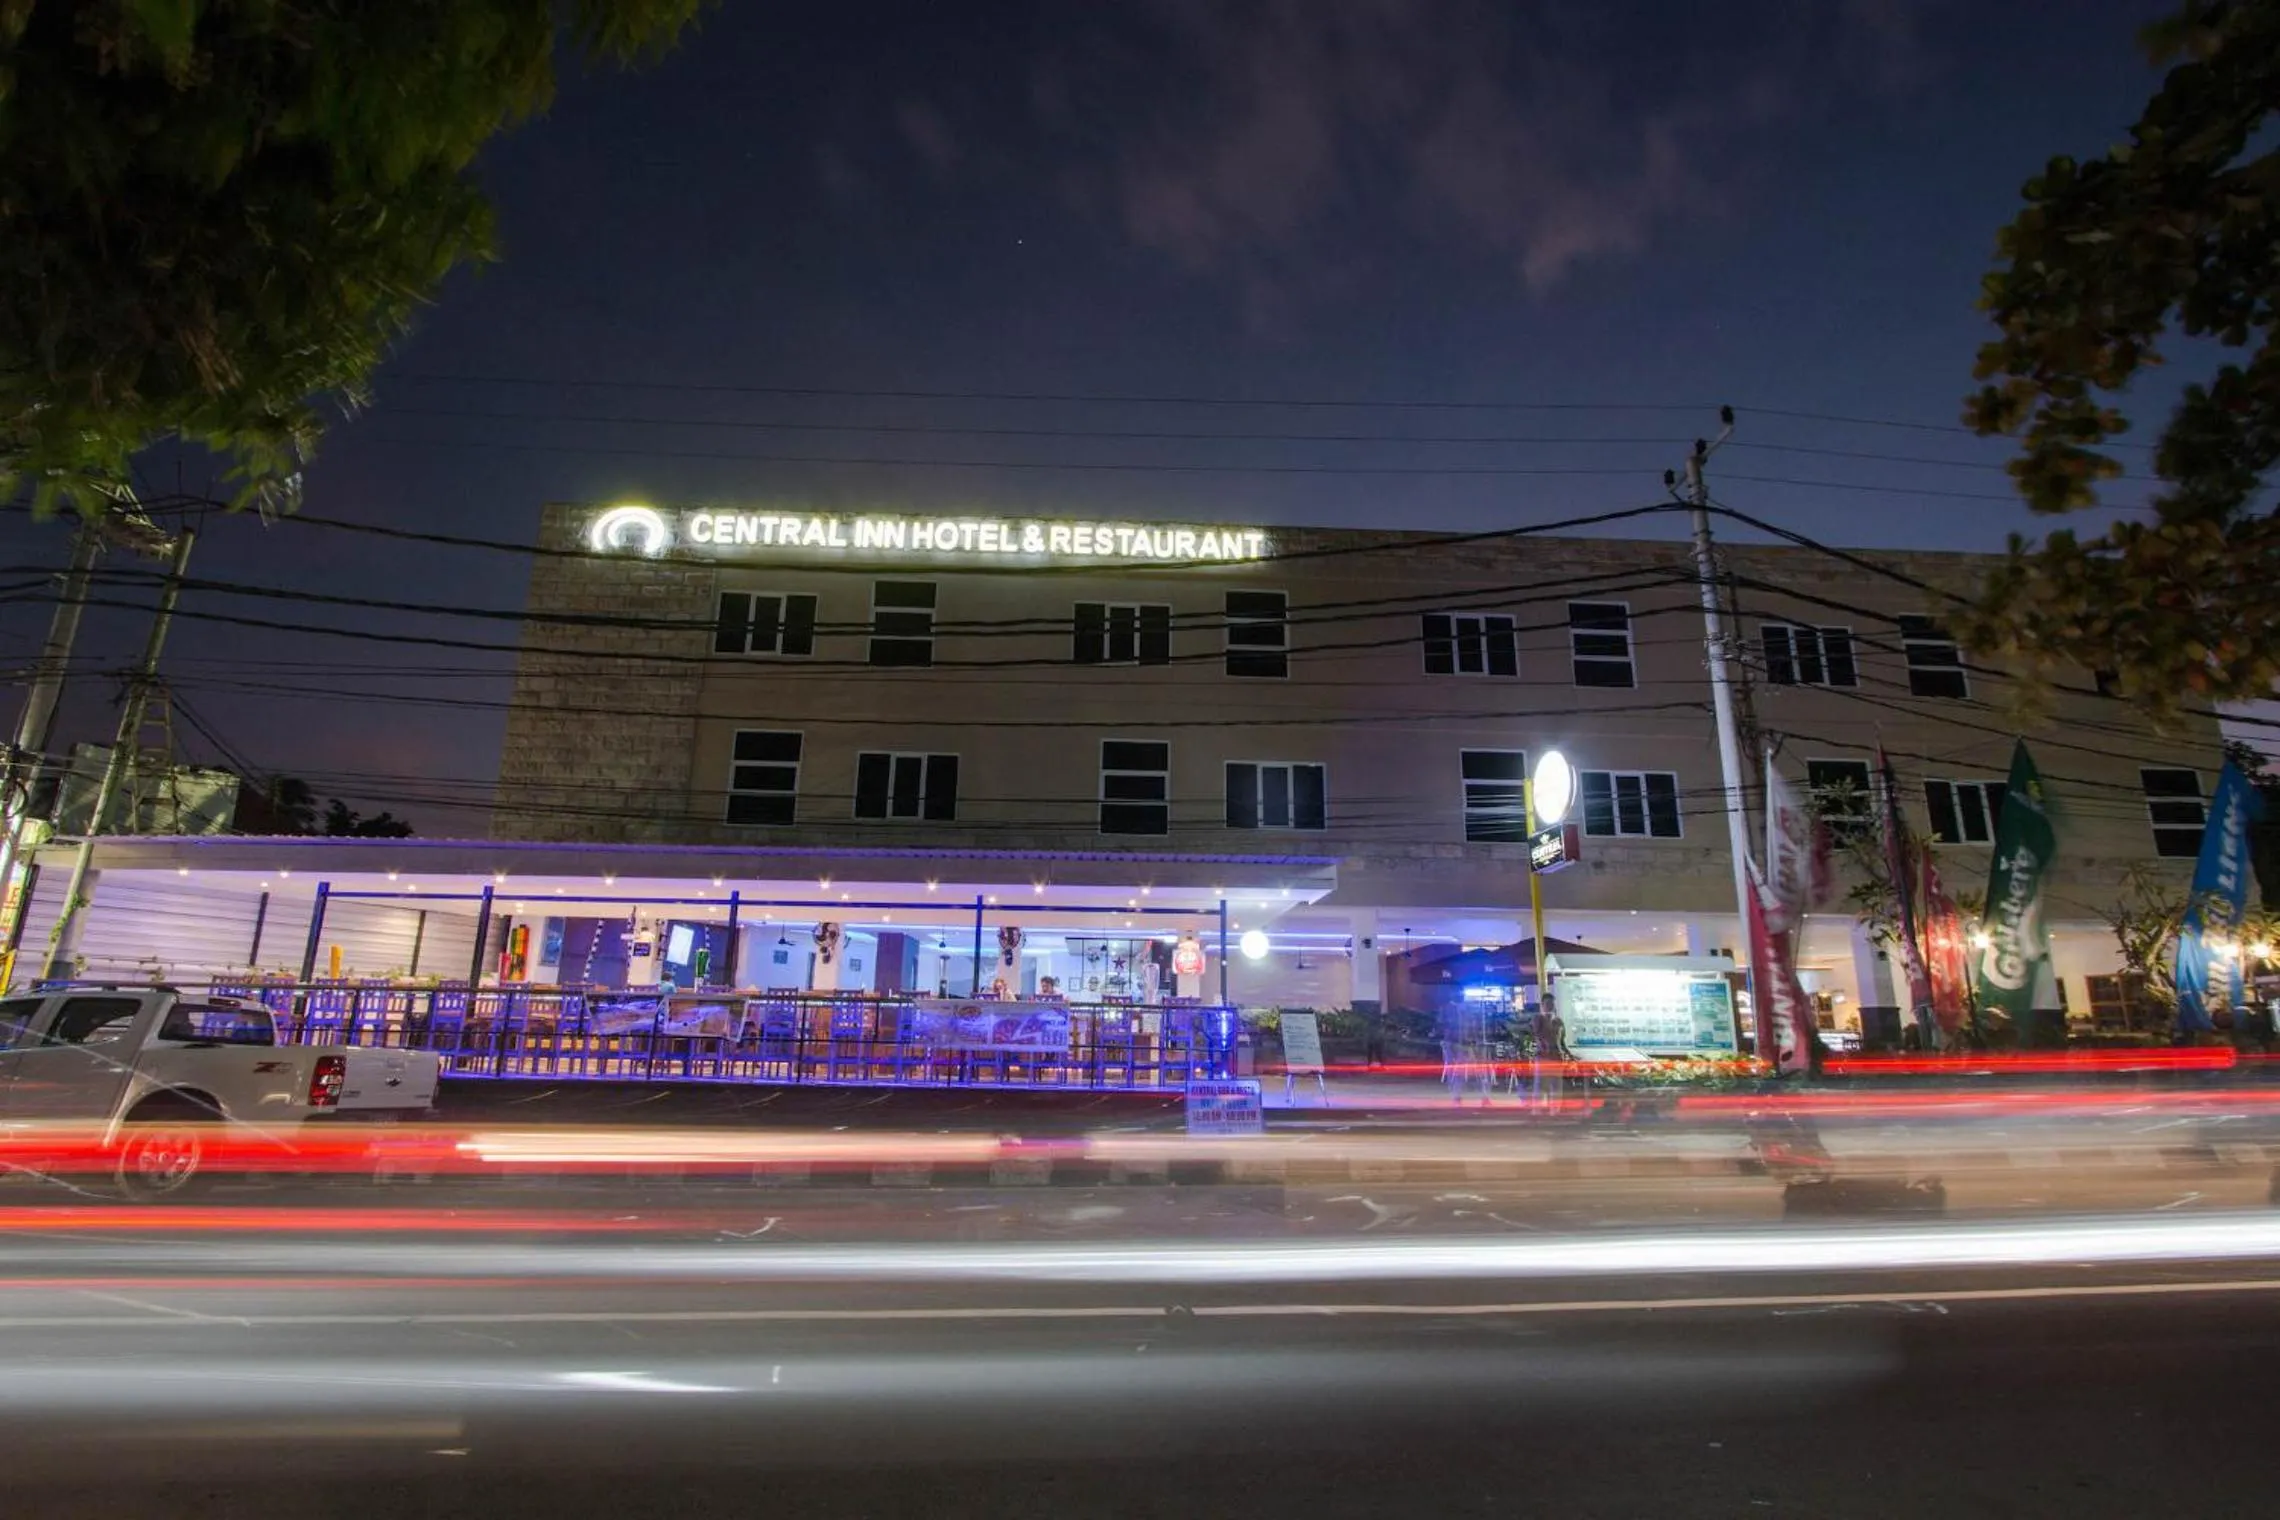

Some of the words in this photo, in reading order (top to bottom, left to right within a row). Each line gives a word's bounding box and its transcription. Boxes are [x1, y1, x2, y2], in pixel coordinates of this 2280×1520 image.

[690, 513, 847, 547] CENTRAL
[854, 518, 906, 549] INN
[912, 522, 1018, 552] HOTEL
[1023, 524, 1046, 552] &
[1050, 525, 1264, 560] RESTAURANT
